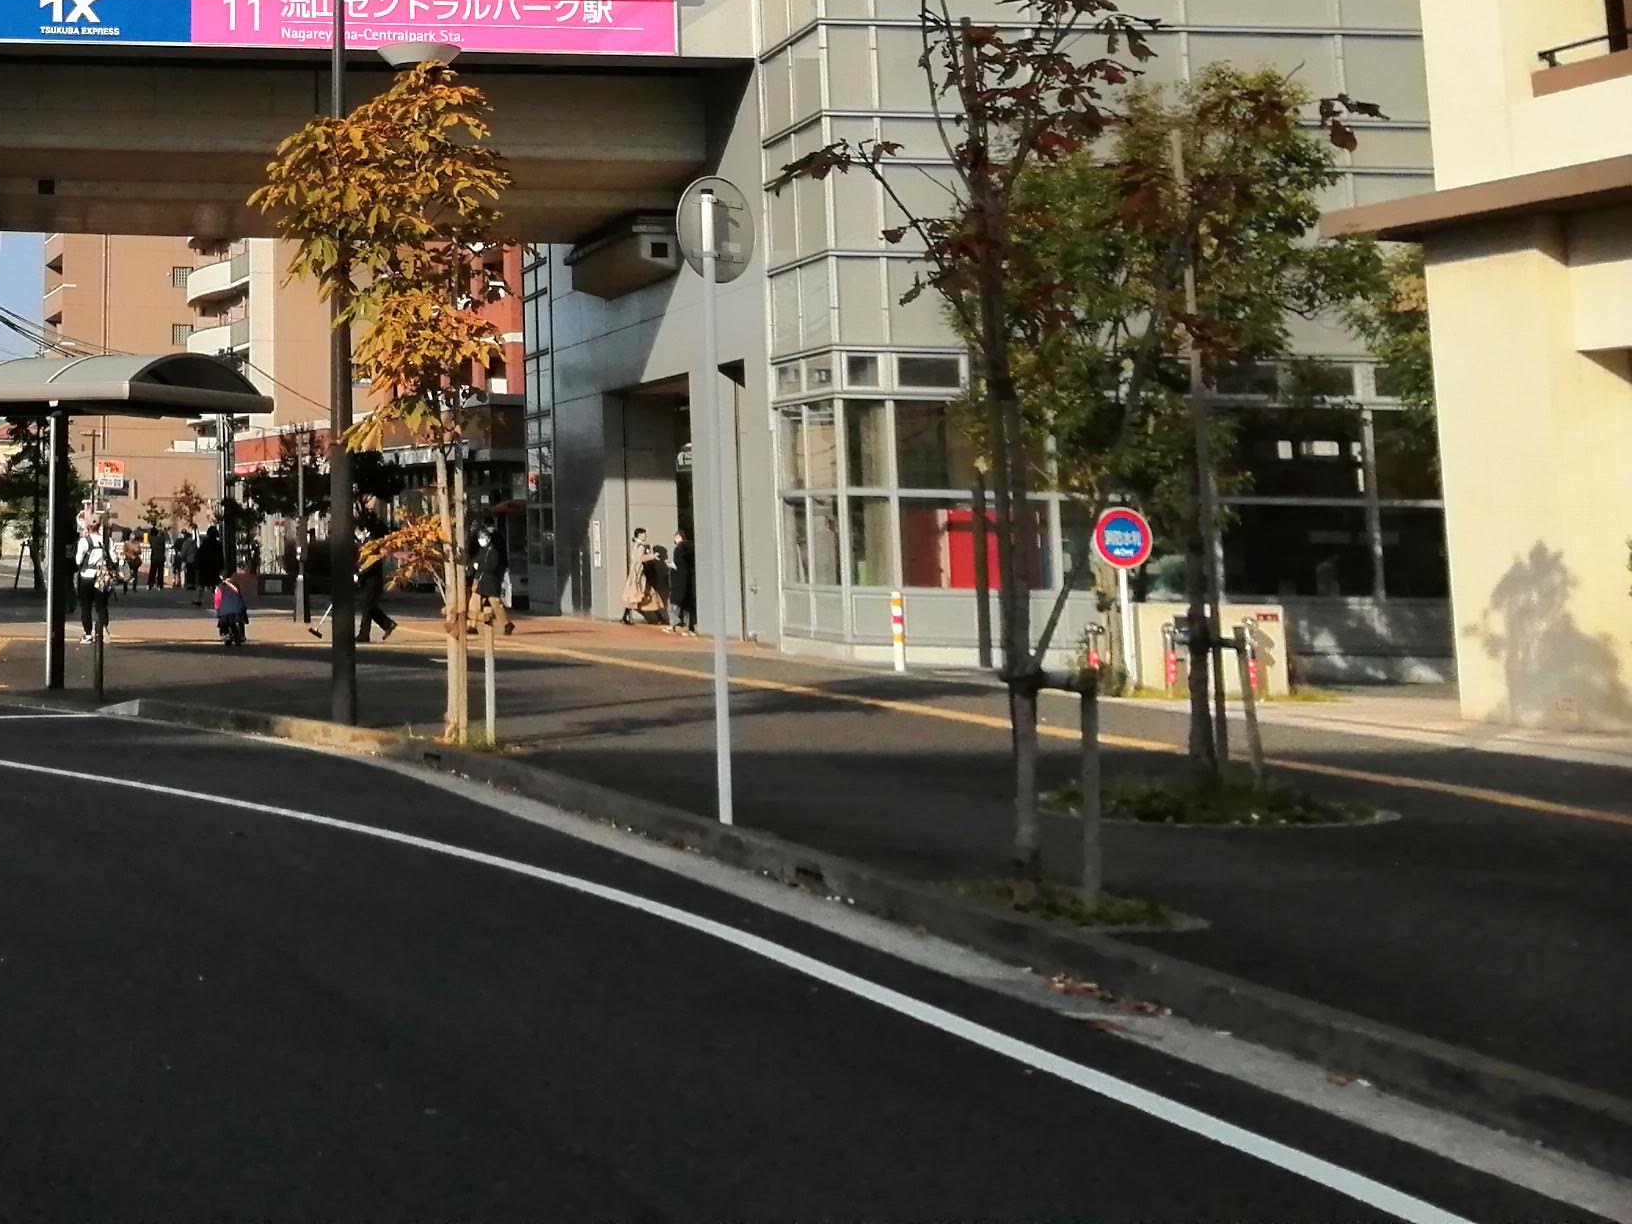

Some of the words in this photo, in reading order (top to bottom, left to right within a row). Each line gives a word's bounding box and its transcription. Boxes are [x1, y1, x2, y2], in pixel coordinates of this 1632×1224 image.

[40, 26, 79, 35] TSUKUBA
[81, 27, 120, 36] EXPRESS
[281, 27, 436, 42] Nagareyma-Centralpark
[440, 29, 465, 42] Sta.
